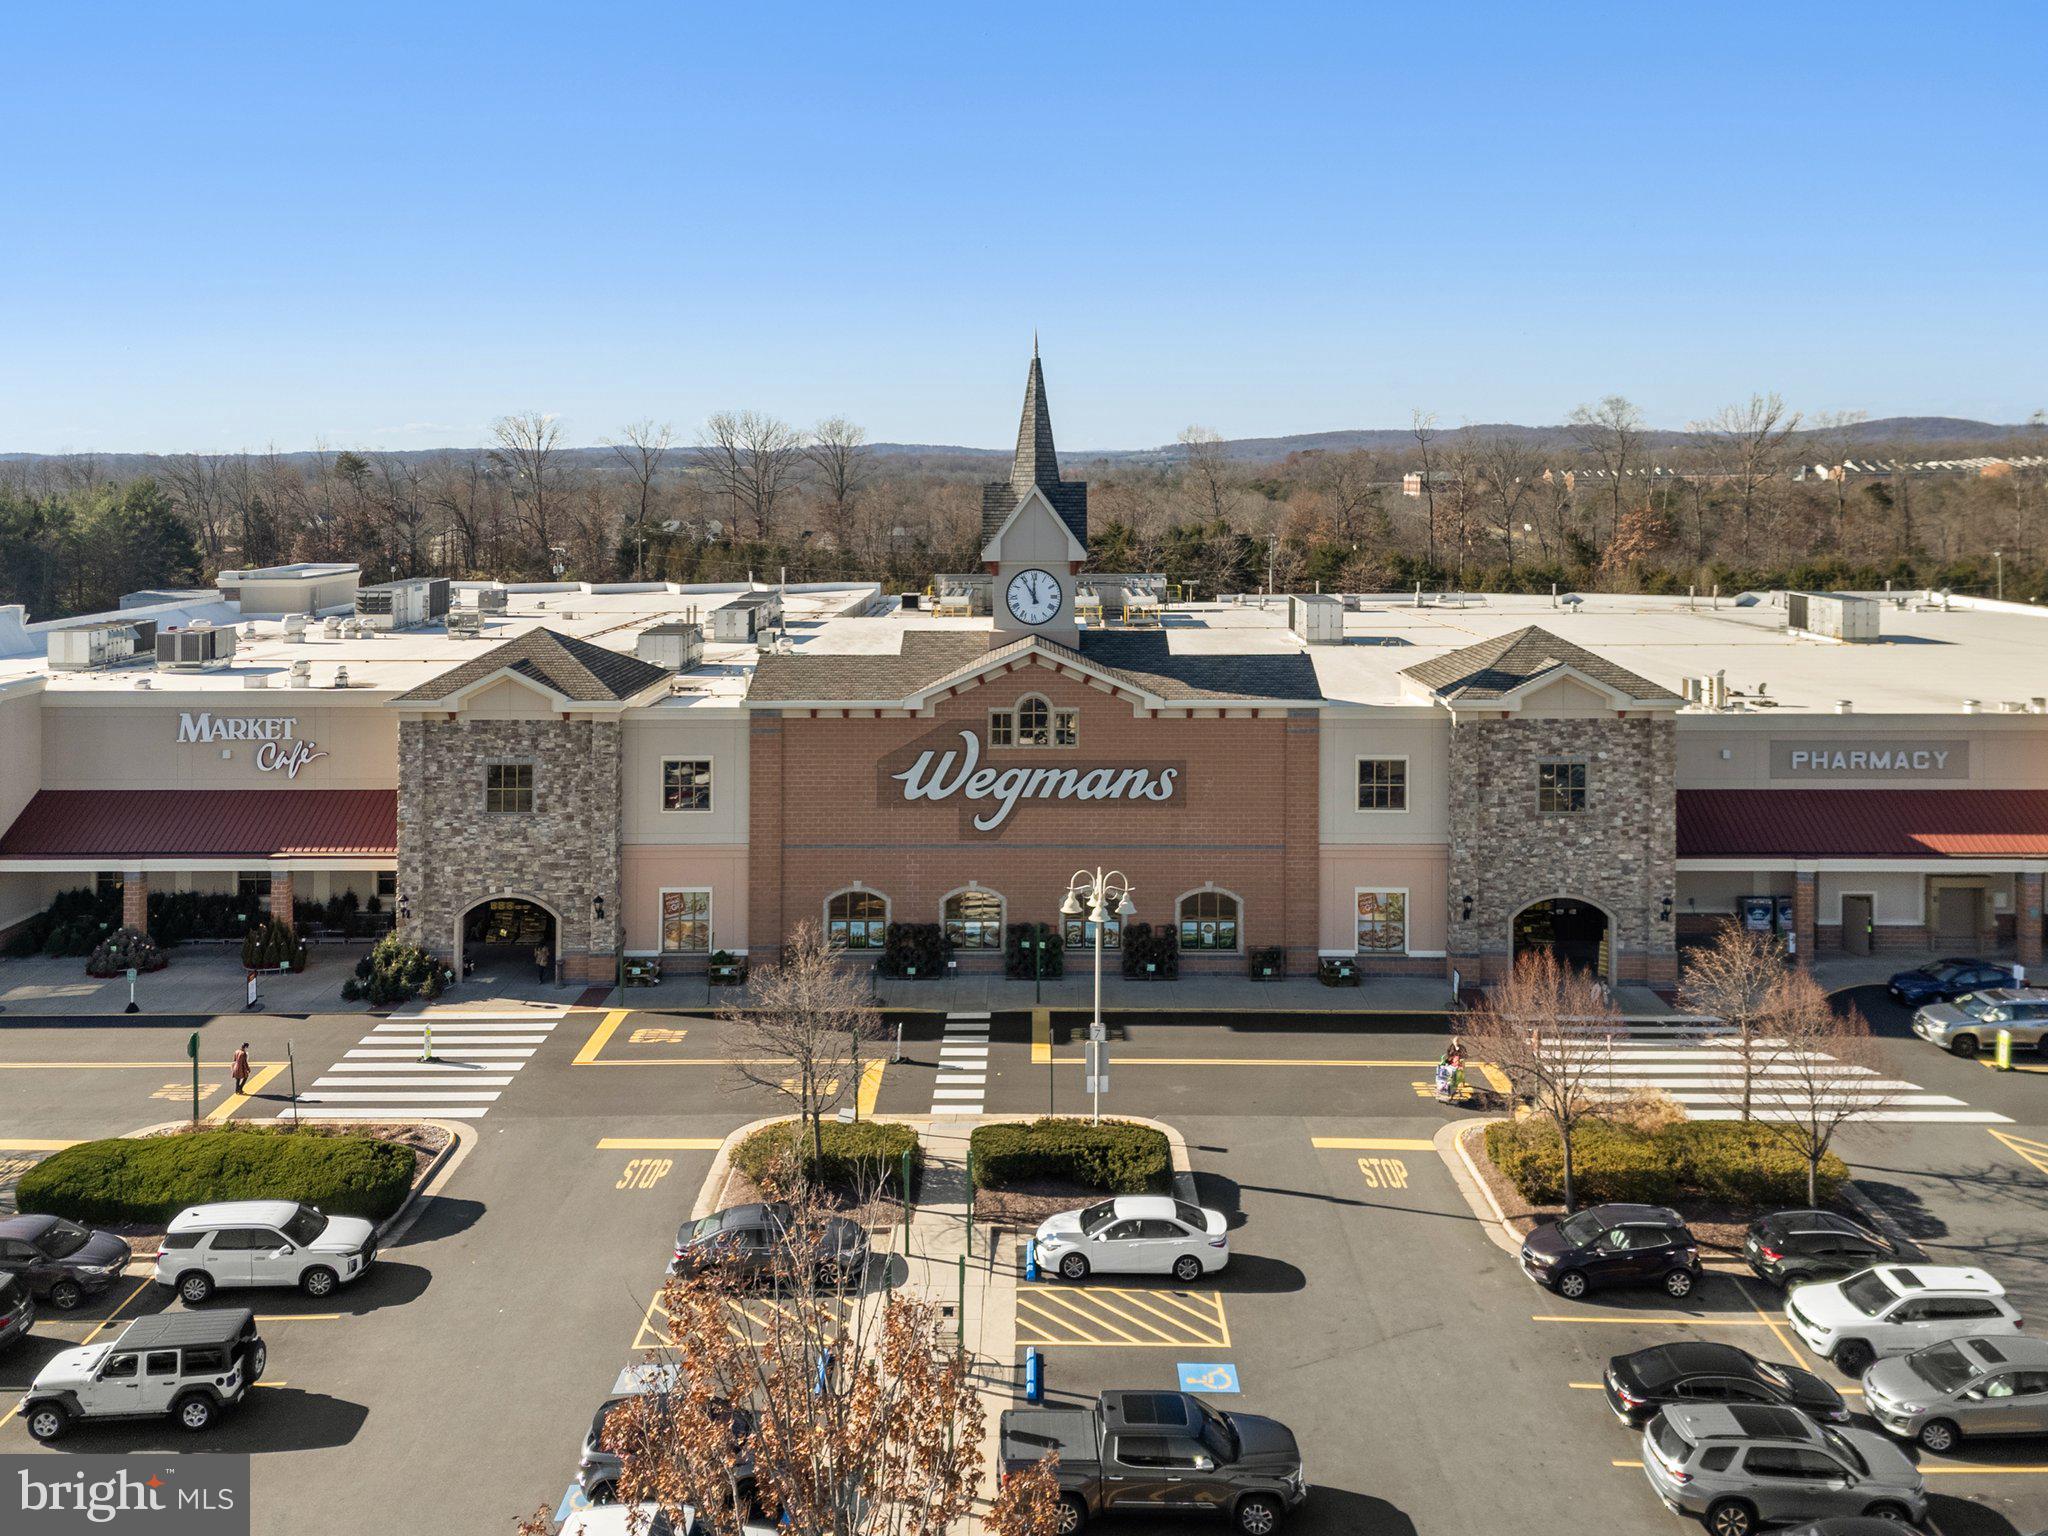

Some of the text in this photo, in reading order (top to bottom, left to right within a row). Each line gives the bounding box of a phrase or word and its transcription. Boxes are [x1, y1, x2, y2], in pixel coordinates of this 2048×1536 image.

[176, 713, 297, 743] MARKET
[256, 740, 329, 779] Café
[1791, 751, 1949, 770] PHARMACY
[891, 730, 1178, 831] Wegmans
[1094, 1029, 1101, 1039] 7
[615, 1158, 674, 1189] STOP
[1357, 1158, 1408, 1188] STOP
